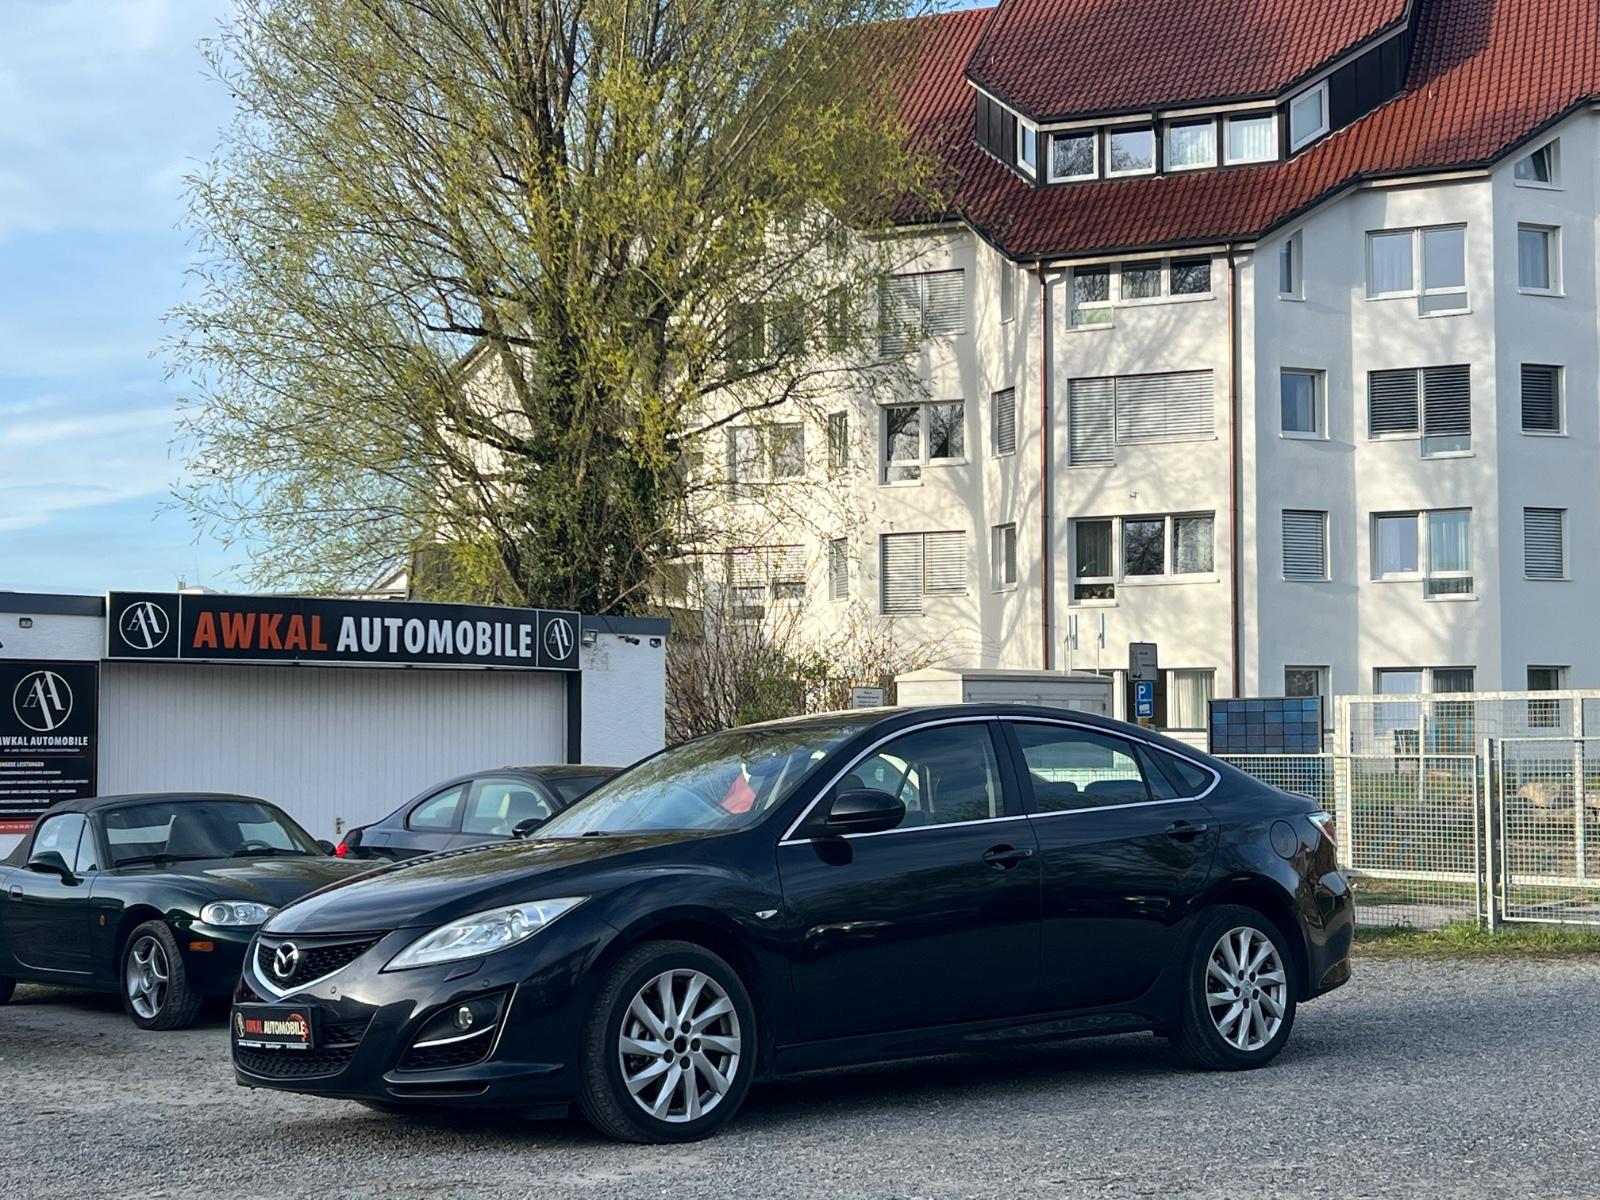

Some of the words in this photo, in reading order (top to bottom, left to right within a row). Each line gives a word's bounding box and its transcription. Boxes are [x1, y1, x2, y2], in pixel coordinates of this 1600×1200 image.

[192, 611, 329, 651] AWKAL
[336, 615, 533, 659] AUTOMOBILE
[1137, 685, 1146, 700] P
[0, 736, 29, 746] WKAL
[30, 736, 89, 746] AUTOMOBILE
[263, 1020, 306, 1036] AUTOMOBILE
